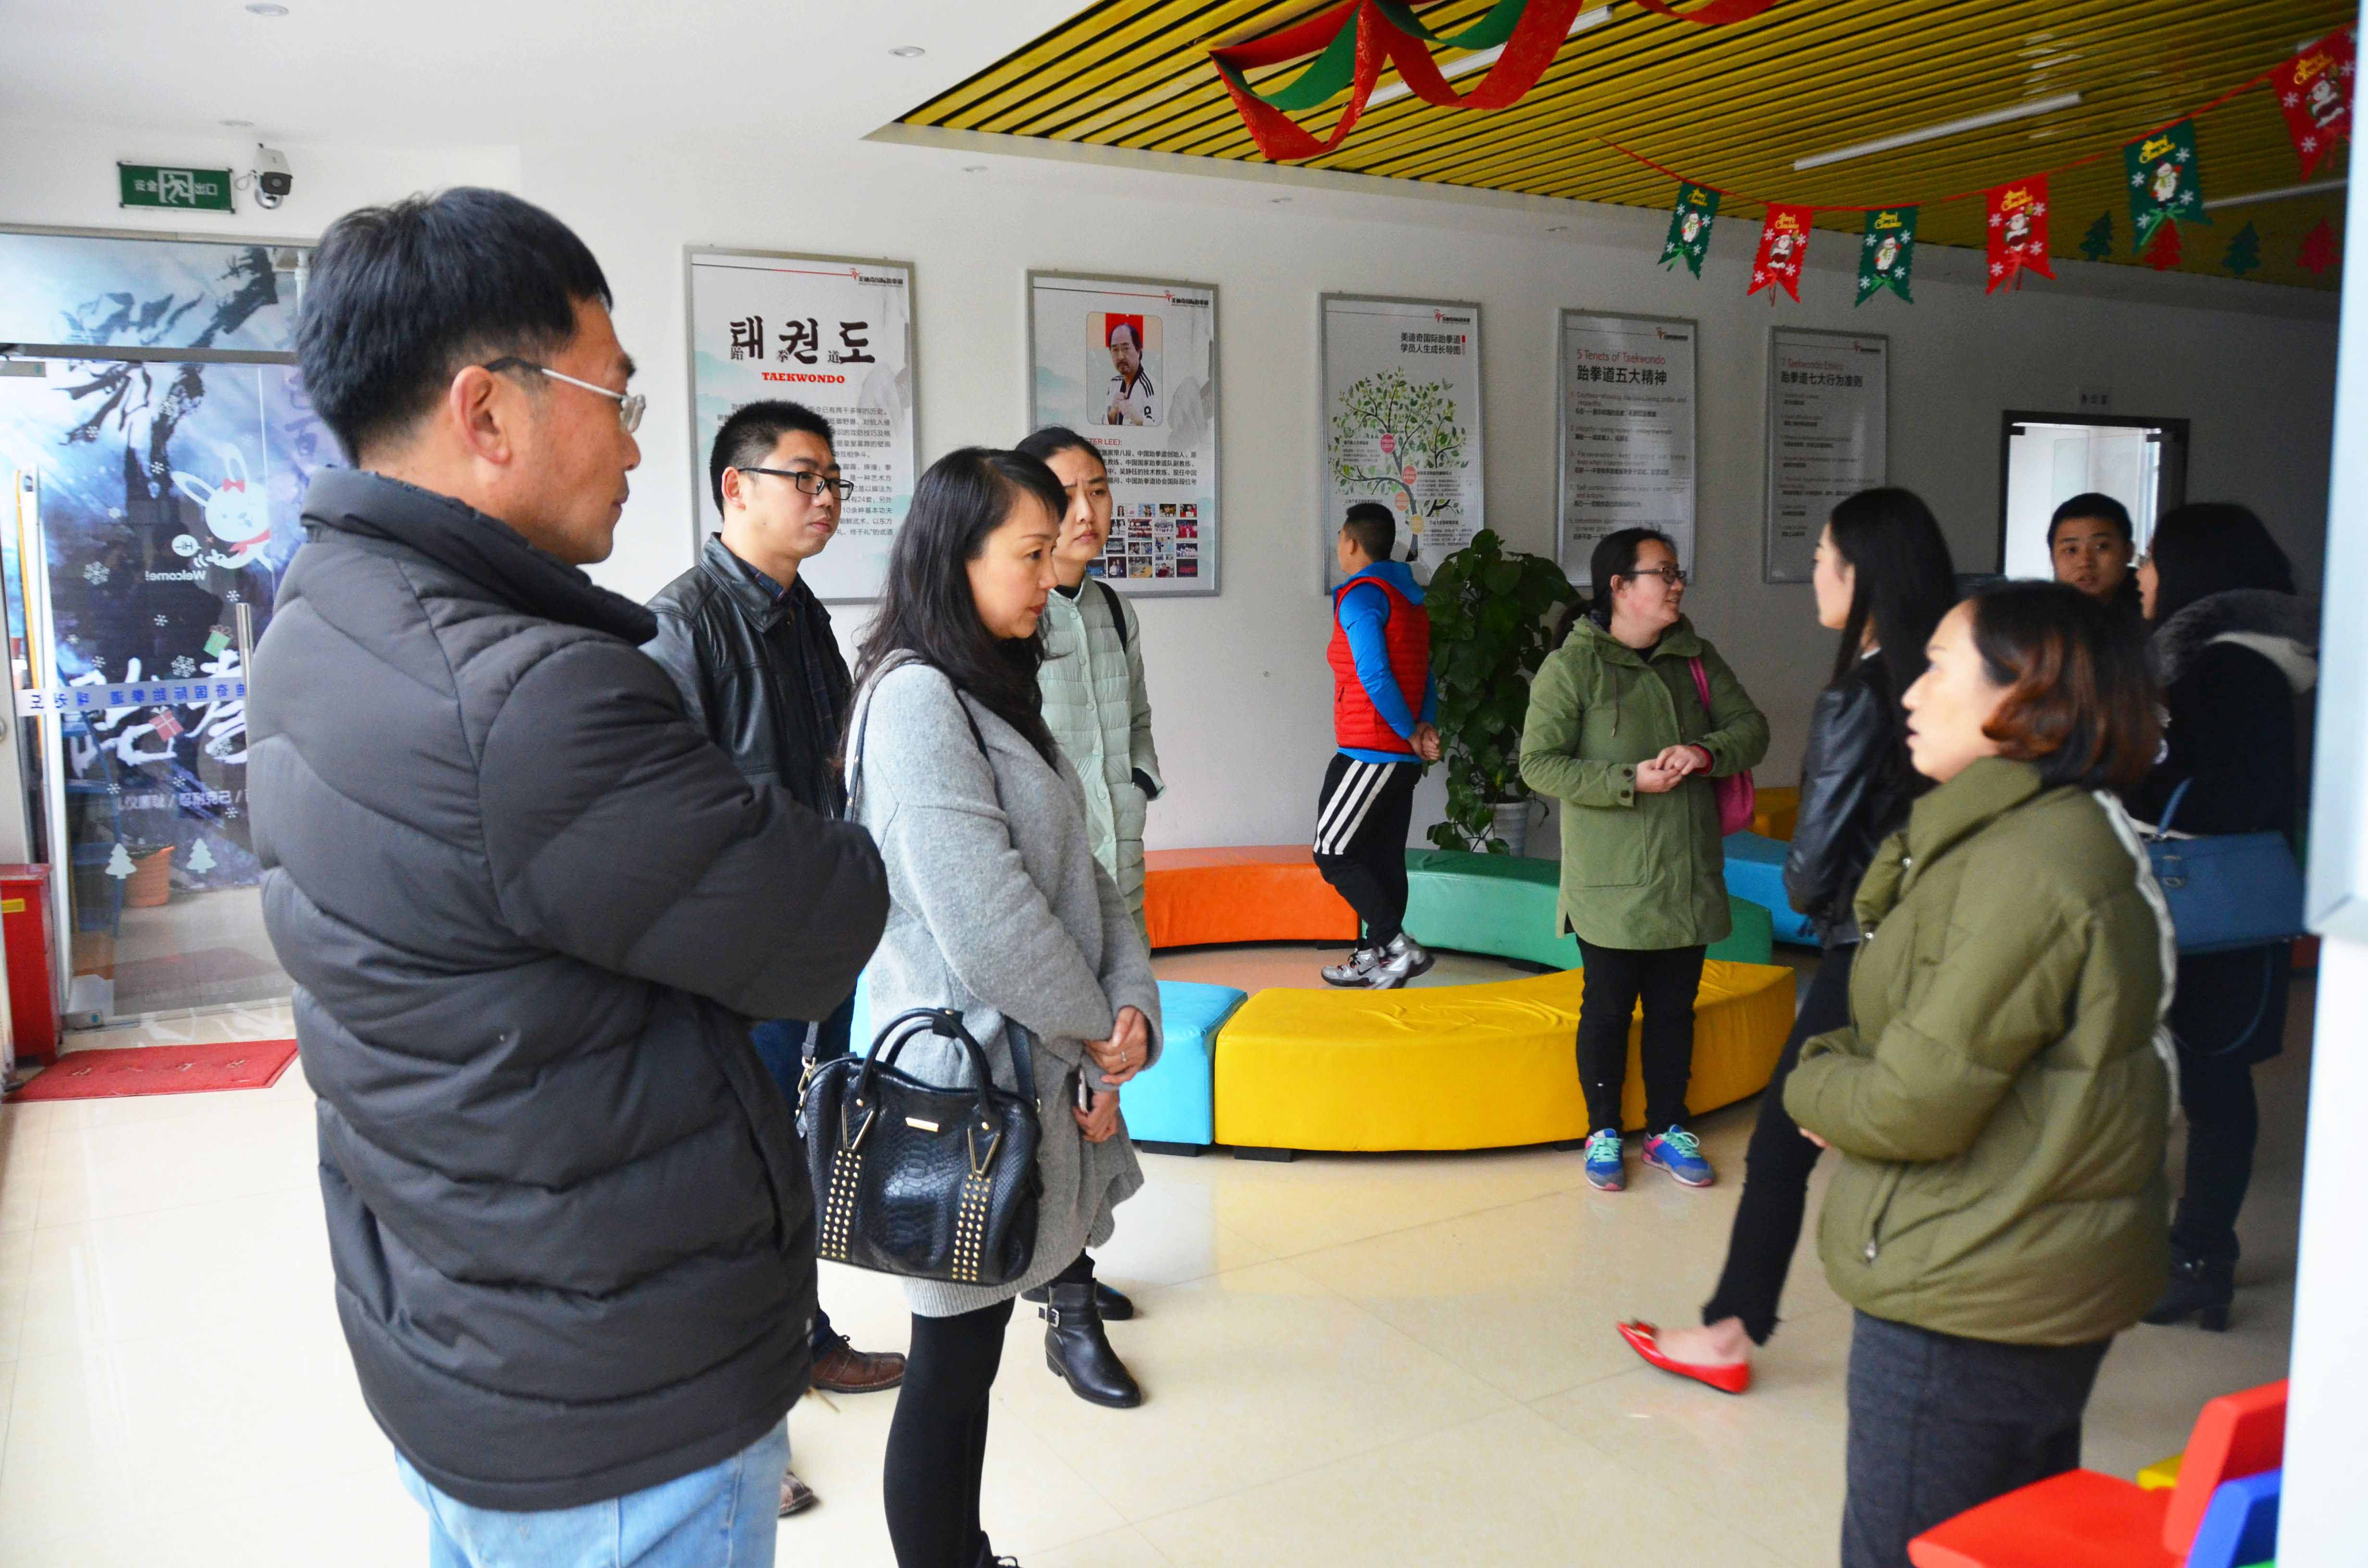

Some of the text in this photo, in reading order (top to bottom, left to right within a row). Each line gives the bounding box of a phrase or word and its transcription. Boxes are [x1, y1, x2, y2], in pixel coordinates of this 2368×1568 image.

[730, 316, 876, 364] 태권도
[1400, 332, 1461, 344] 美迪奇国际跆拳道
[1400, 343, 1461, 355] 学员人生成长导图
[1585, 349, 1609, 361] Tenets
[1612, 351, 1620, 362] of
[1622, 352, 1666, 365] Taekwondo
[762, 371, 845, 383] TAEKWONDO
[1577, 365, 1667, 385] 跆拳道五大精神
